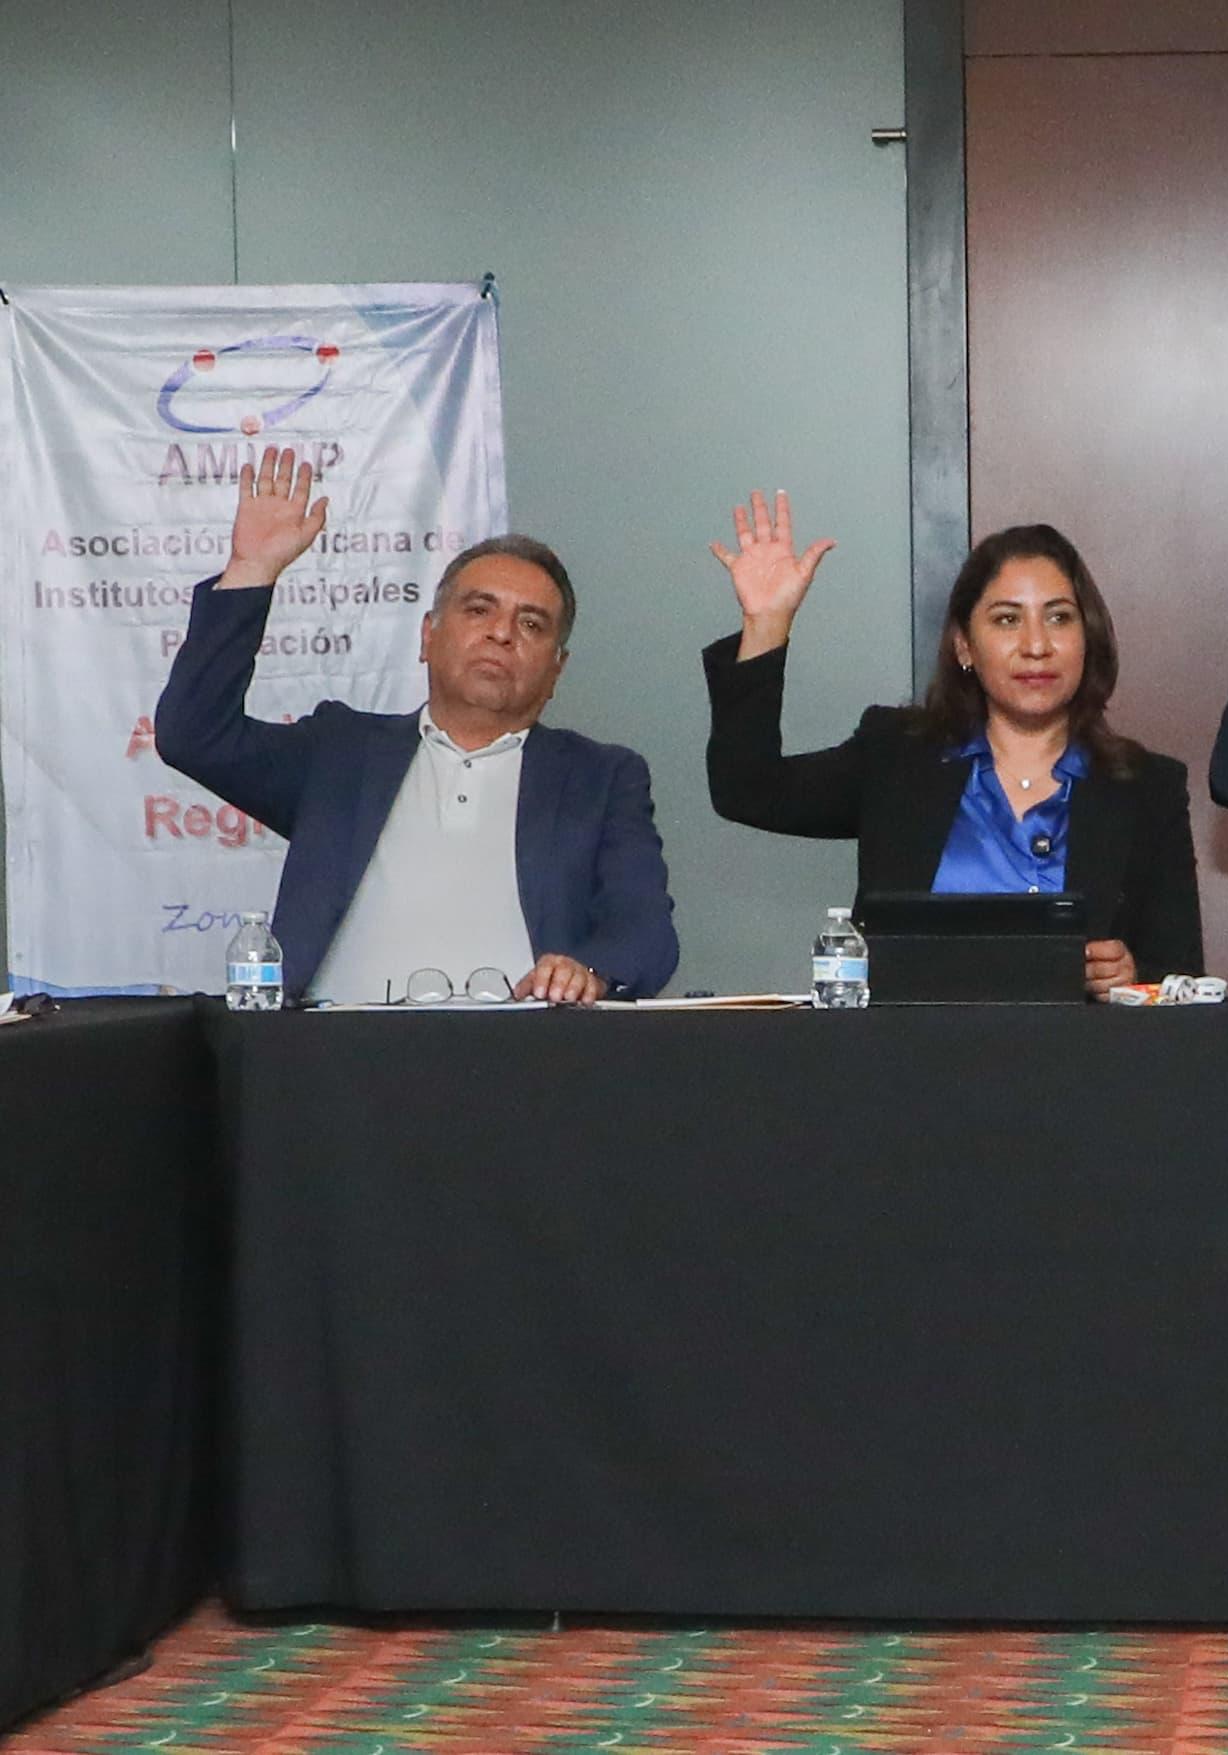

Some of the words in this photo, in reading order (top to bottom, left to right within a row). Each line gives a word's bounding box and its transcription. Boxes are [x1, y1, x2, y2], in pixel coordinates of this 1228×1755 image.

[159, 442, 344, 485] AMIP
[312, 530, 412, 553] icana
[277, 576, 420, 611] icipales
[161, 627, 351, 657] Pación
[162, 904, 244, 932] Zon
